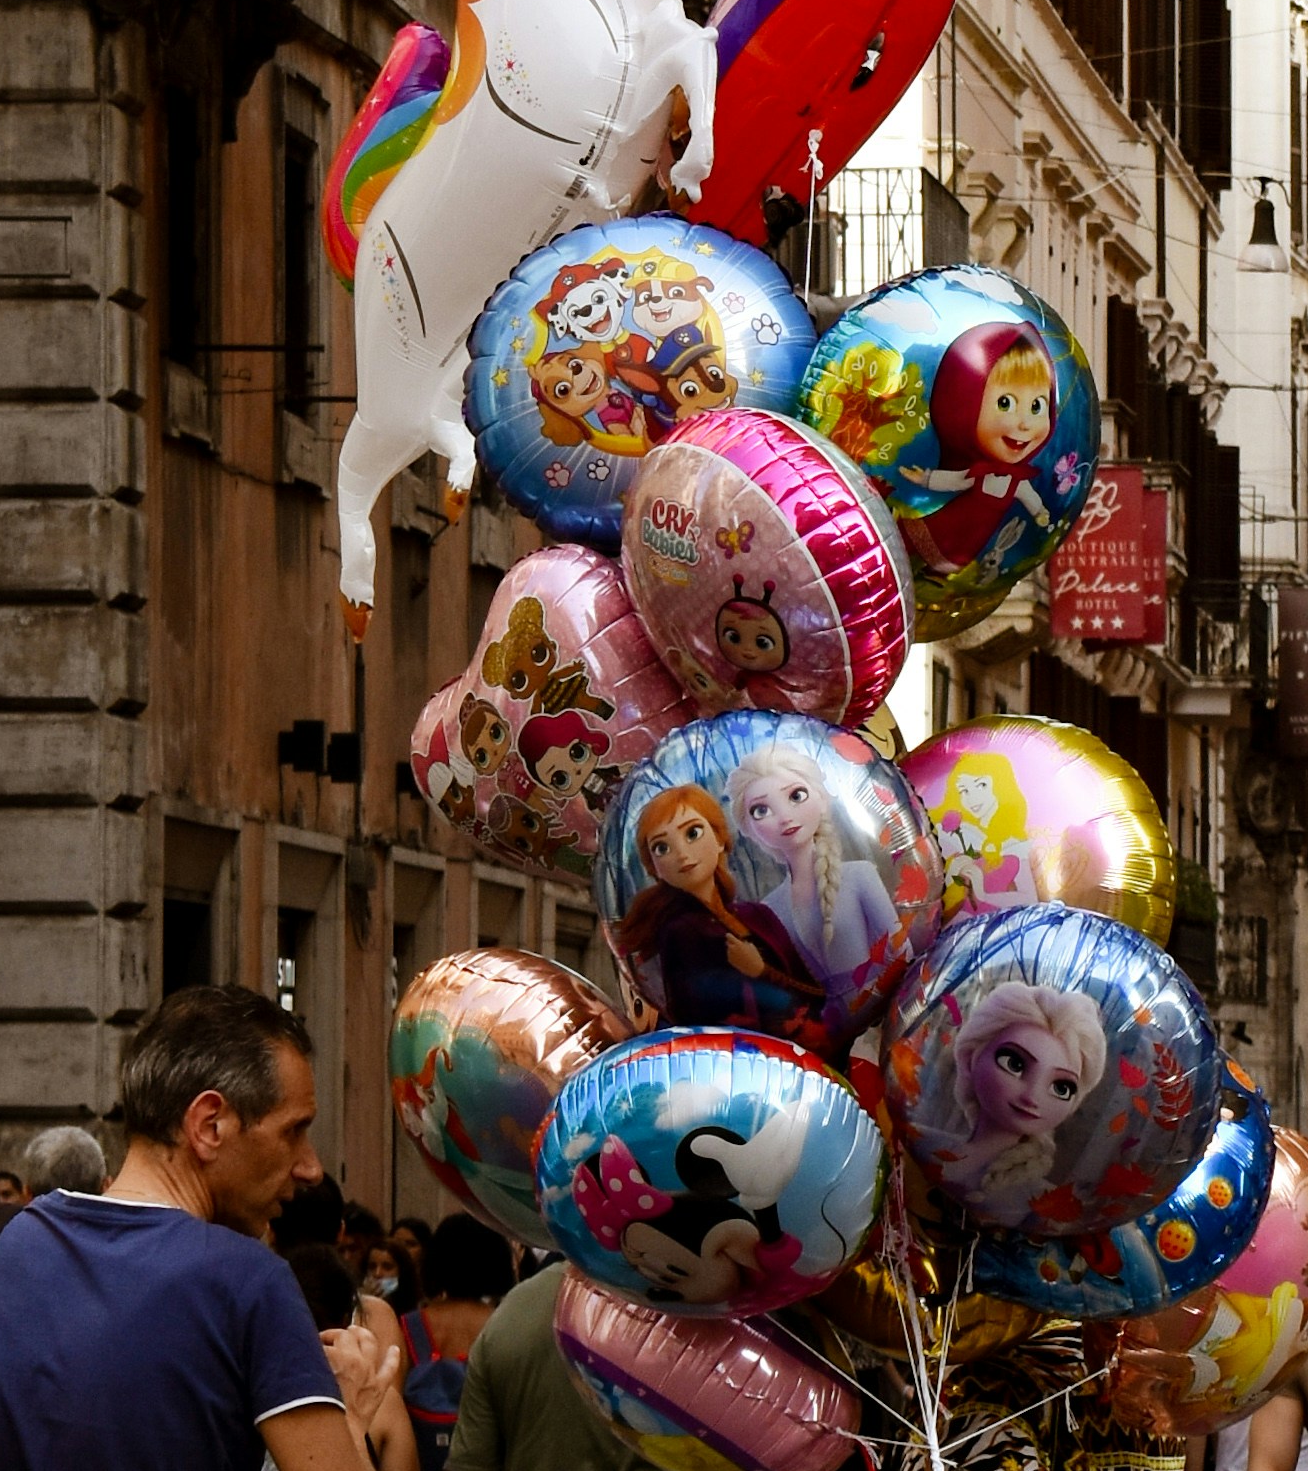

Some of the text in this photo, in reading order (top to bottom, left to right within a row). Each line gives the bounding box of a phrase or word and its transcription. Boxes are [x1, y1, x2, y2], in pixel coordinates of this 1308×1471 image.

[652, 498, 695, 537] CRY
[1058, 541, 1138, 554] BOUTIQUE
[1057, 555, 1138, 567] CENTRALE
[1054, 568, 1141, 600] Palace
[1076, 599, 1119, 610] HOTEL
